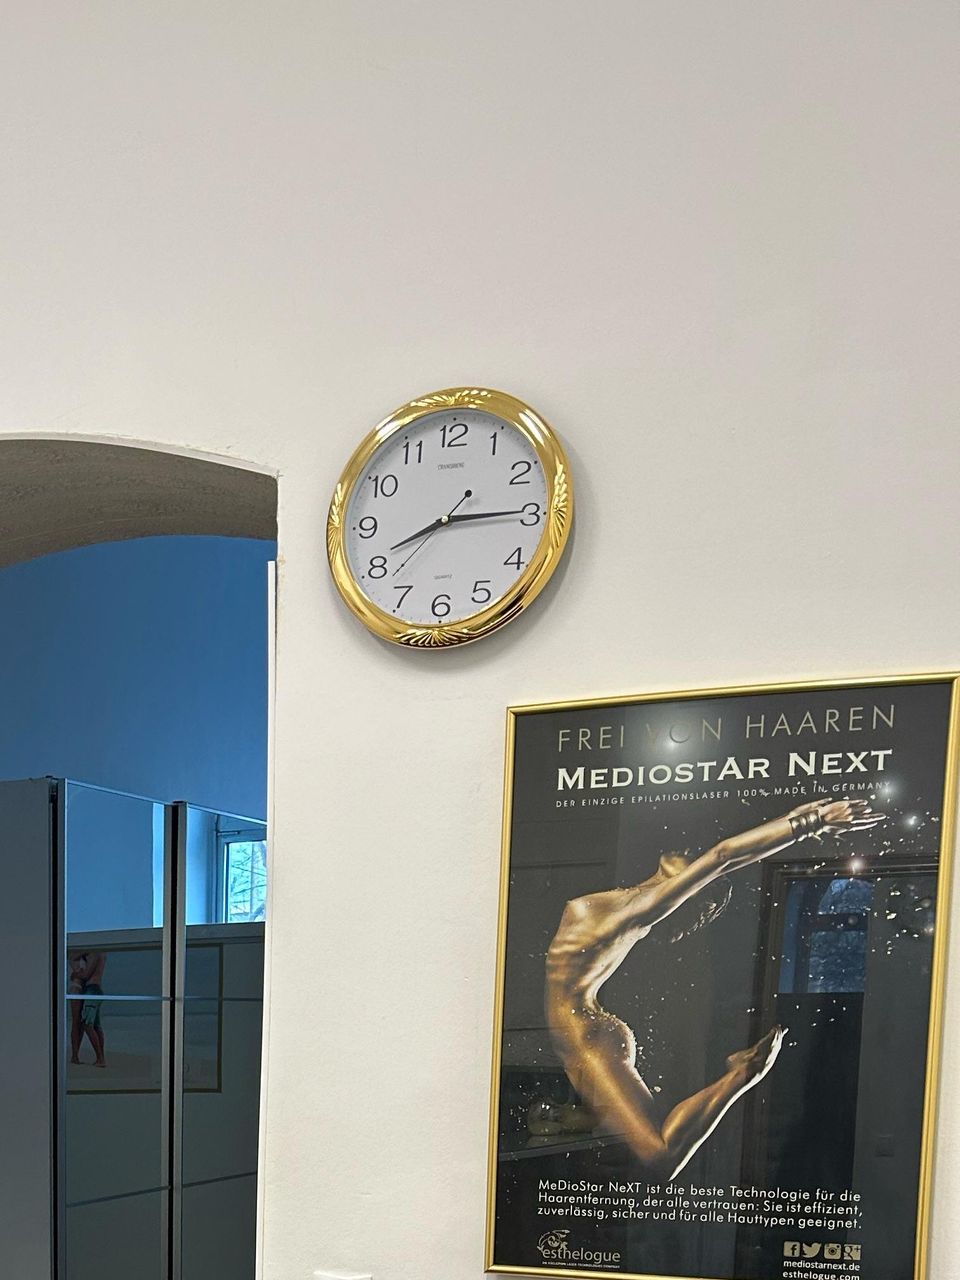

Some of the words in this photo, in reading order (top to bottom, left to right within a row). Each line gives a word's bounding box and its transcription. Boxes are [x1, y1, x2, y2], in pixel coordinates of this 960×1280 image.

[440, 422, 469, 449] 12
[490, 431, 497, 456] 1
[402, 440, 423, 465] 11
[509, 460, 532, 486] 2
[371, 474, 399, 499] 10
[520, 502, 541, 527] 3
[358, 516, 378, 539] 9
[367, 555, 388, 579] 8
[503, 546, 525, 571] 4
[393, 585, 414, 609] 7
[471, 580, 492, 604] 5
[431, 593, 451, 617] 6
[558, 725, 625, 752] FREI
[745, 704, 895, 738] HAAREN
[557, 756, 770, 791] MEDIOSTAR
[788, 749, 893, 776] NEXT
[556, 800, 575, 808] DER
[582, 796, 625, 807] EINZIGE
[631, 790, 730, 804] EPILATIONSLASER
[774, 786, 807, 796] MADE
[813, 783, 825, 793] IN
[538, 1179, 604, 1193] MeDioStar
[609, 1181, 641, 1193] NeXT
[646, 1183, 660, 1194] ist
[665, 1183, 685, 1195] die
[690, 1184, 724, 1197] beste
[730, 1185, 810, 1201] Technologie
[815, 1188, 835, 1200] für
[840, 1189, 861, 1202] die
[538, 1192, 640, 1208] Haarentfernung,
[643, 1195, 664, 1207] der
[666, 1196, 690, 1208] alle
[693, 1199, 759, 1211] vertrauen:
[763, 1200, 782, 1212] Sie
[786, 1201, 801, 1213] ist
[804, 1202, 863, 1217] effizient,
[537, 1205, 609, 1220] zuverlässig,
[612, 1206, 649, 1219] sicher
[652, 1210, 675, 1221] und
[679, 1209, 697, 1221] für
[700, 1211, 724, 1222] alle
[727, 1212, 794, 1228] Hauttypen
[798, 1216, 862, 1230] geeignet.
[542, 1247, 621, 1264] esthelogue
[783, 1260, 860, 1271] mediostarnext.de
